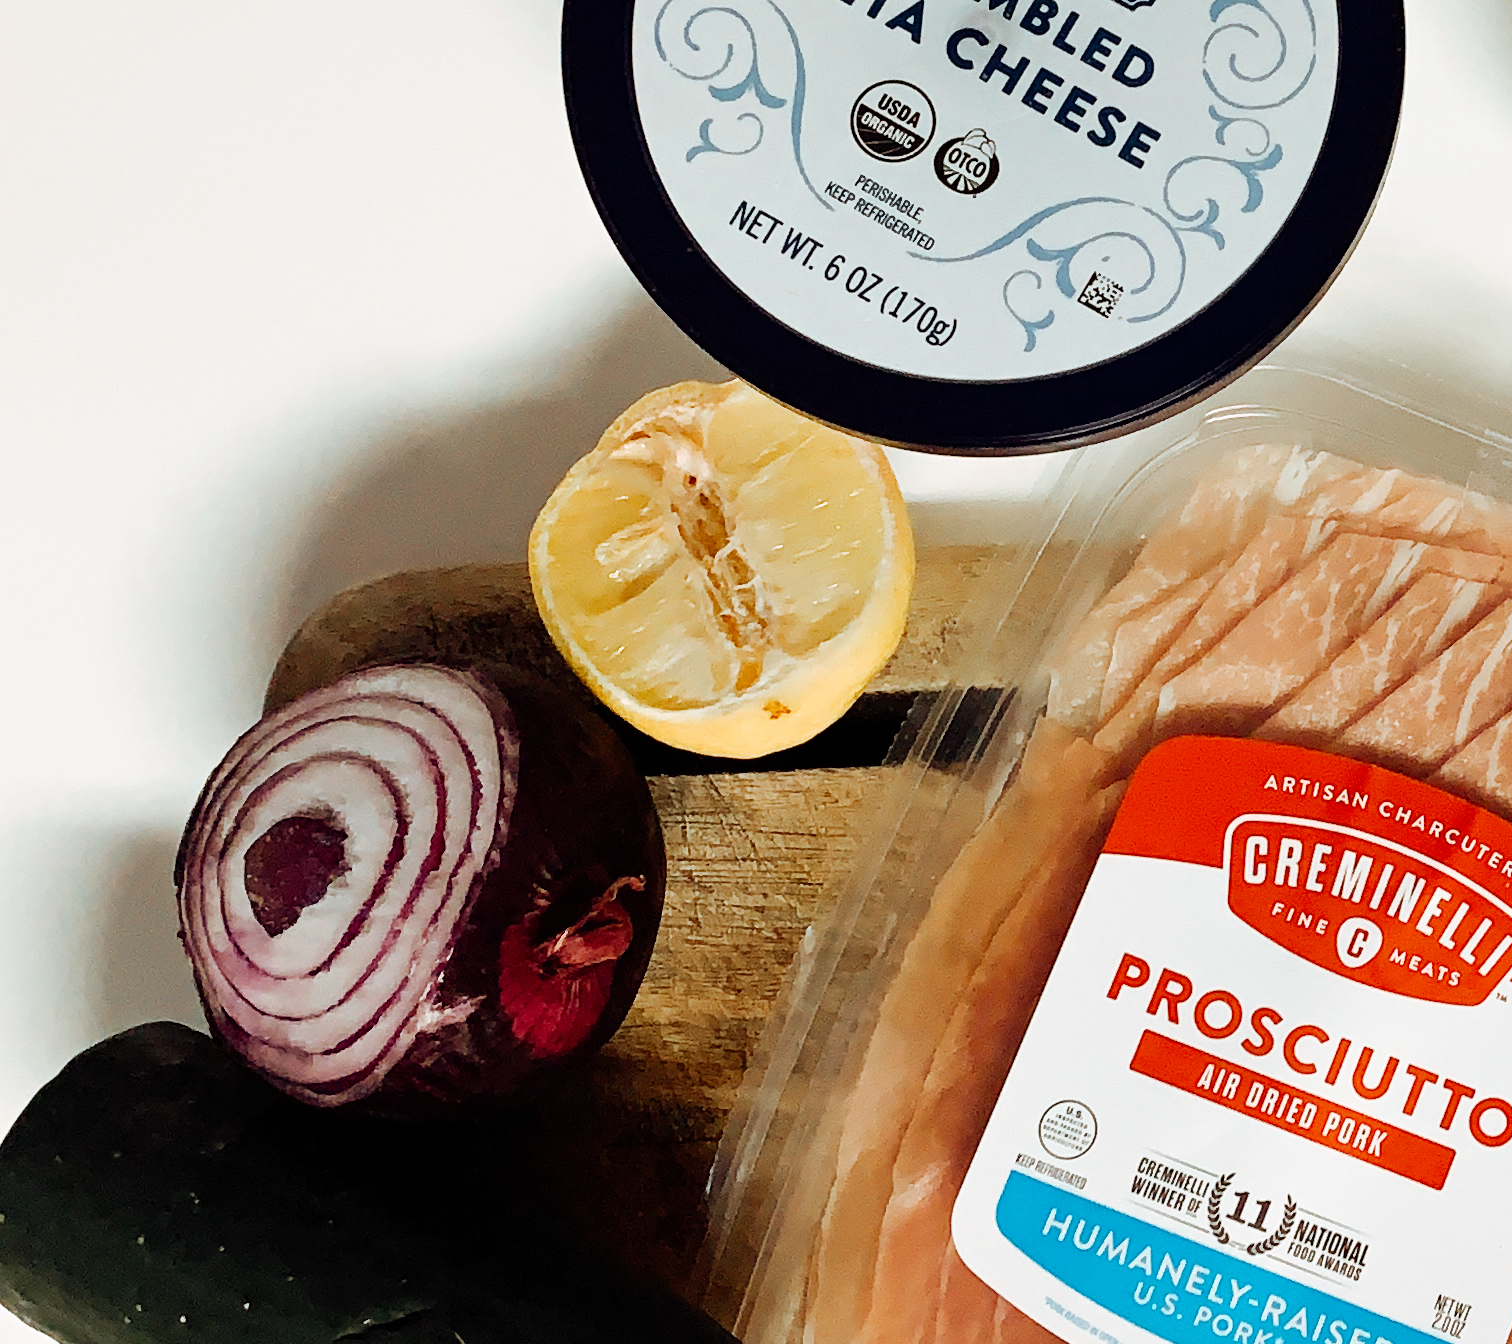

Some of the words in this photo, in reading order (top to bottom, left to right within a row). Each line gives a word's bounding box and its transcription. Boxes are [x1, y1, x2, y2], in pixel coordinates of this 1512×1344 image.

[877, 93, 921, 128] USDA
[946, 27, 1162, 170] CHEESE
[860, 112, 916, 149] ORGANIC
[948, 147, 987, 179] OTCO
[824, 181, 856, 205] KEEP
[853, 197, 935, 251] REFRIGERATED
[854, 174, 925, 224] PERISHABLE,
[729, 200, 784, 244] NET
[780, 227, 824, 271] WT.
[824, 255, 846, 281] 6
[845, 266, 884, 303] OZ
[880, 286, 958, 347] (170g)
[1263, 774, 1368, 810] ARTISAN
[1271, 902, 1329, 935] FINE
[1389, 948, 1461, 987] MEATS
[1196, 1063, 1241, 1100] AIR
[1245, 1084, 1318, 1130] DRIED
[1321, 1112, 1389, 1158] PORK
[1015, 1153, 1036, 1168] KEEP
[1137, 1157, 1210, 1198] CREMINELLI
[1130, 1175, 1186, 1212] WINNER
[1187, 1197, 1203, 1213] OF
[1225, 1191, 1272, 1233] 11
[1287, 1241, 1315, 1263] FOOD
[1317, 1254, 1363, 1282] AWARDS
[1293, 1219, 1370, 1267] NATIONAL
[1134, 1281, 1183, 1320] U.S.
[1434, 1294, 1456, 1315] NET
[1454, 1301, 1473, 1321] WT
